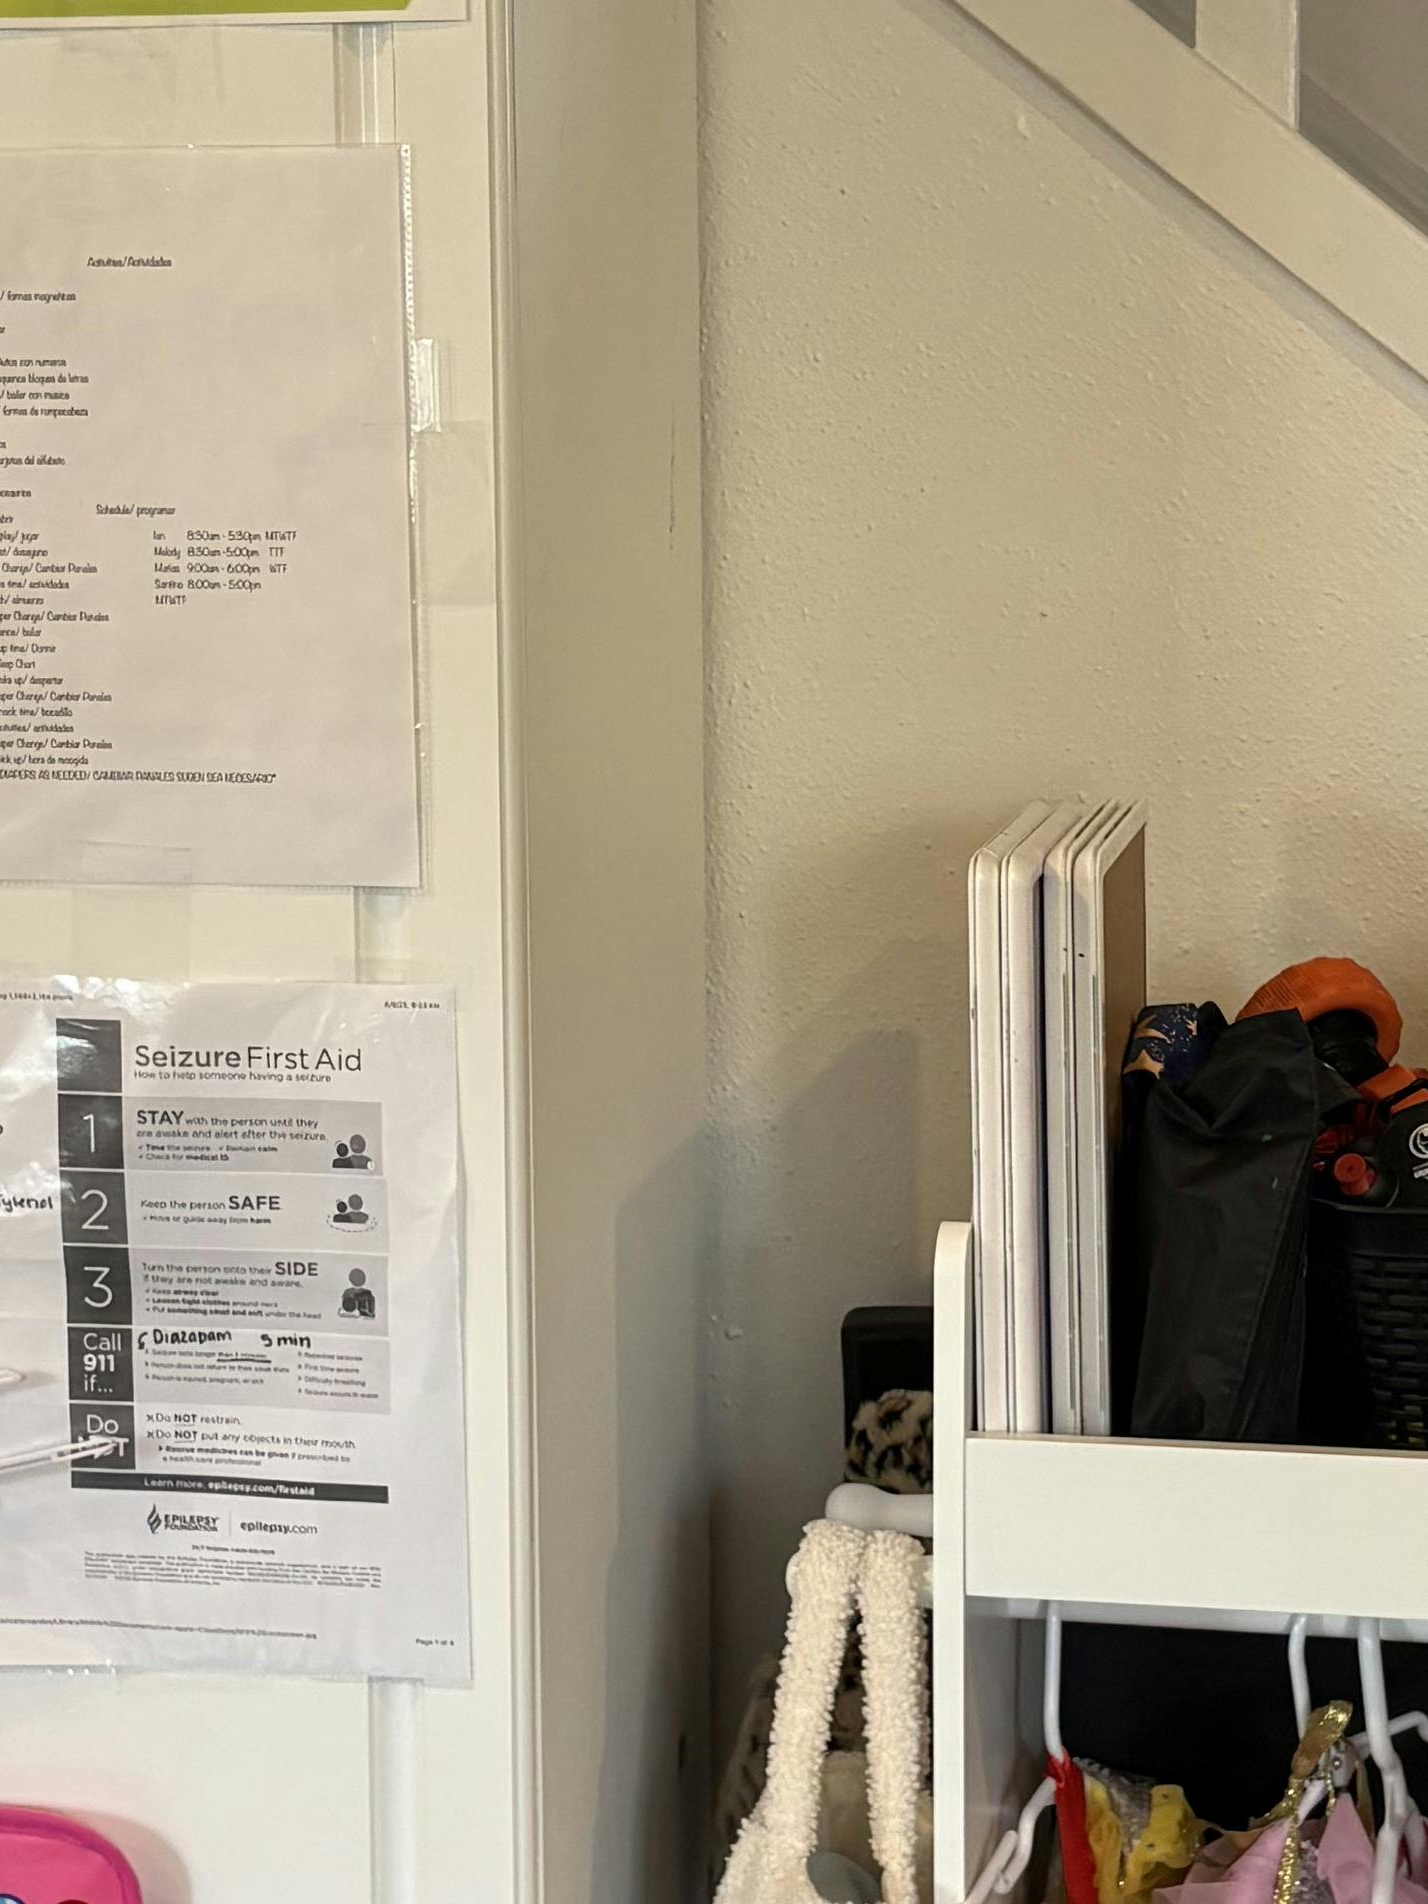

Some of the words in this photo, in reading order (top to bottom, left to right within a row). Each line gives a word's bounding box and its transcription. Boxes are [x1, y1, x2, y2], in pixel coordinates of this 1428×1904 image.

[134, 1045, 242, 1069] Seizure
[247, 1046, 309, 1071] First
[315, 1047, 363, 1072] Aid
[136, 1109, 185, 1127] STAY
[82, 1114, 96, 1153] 1
[81, 1189, 110, 1231] 2
[228, 1195, 282, 1211] SAFE
[274, 1261, 320, 1277] SIDE
[83, 1266, 114, 1309] 3
[83, 1332, 122, 1352] Call
[277, 1333, 312, 1348] min
[83, 1354, 115, 1373] 911
[86, 1413, 120, 1435] Do
[173, 1413, 198, 1424] NOT
[174, 1429, 198, 1441] NOT
[163, 1513, 220, 1526] EPILEPSY
[239, 1519, 319, 1537] epilepsy.com
